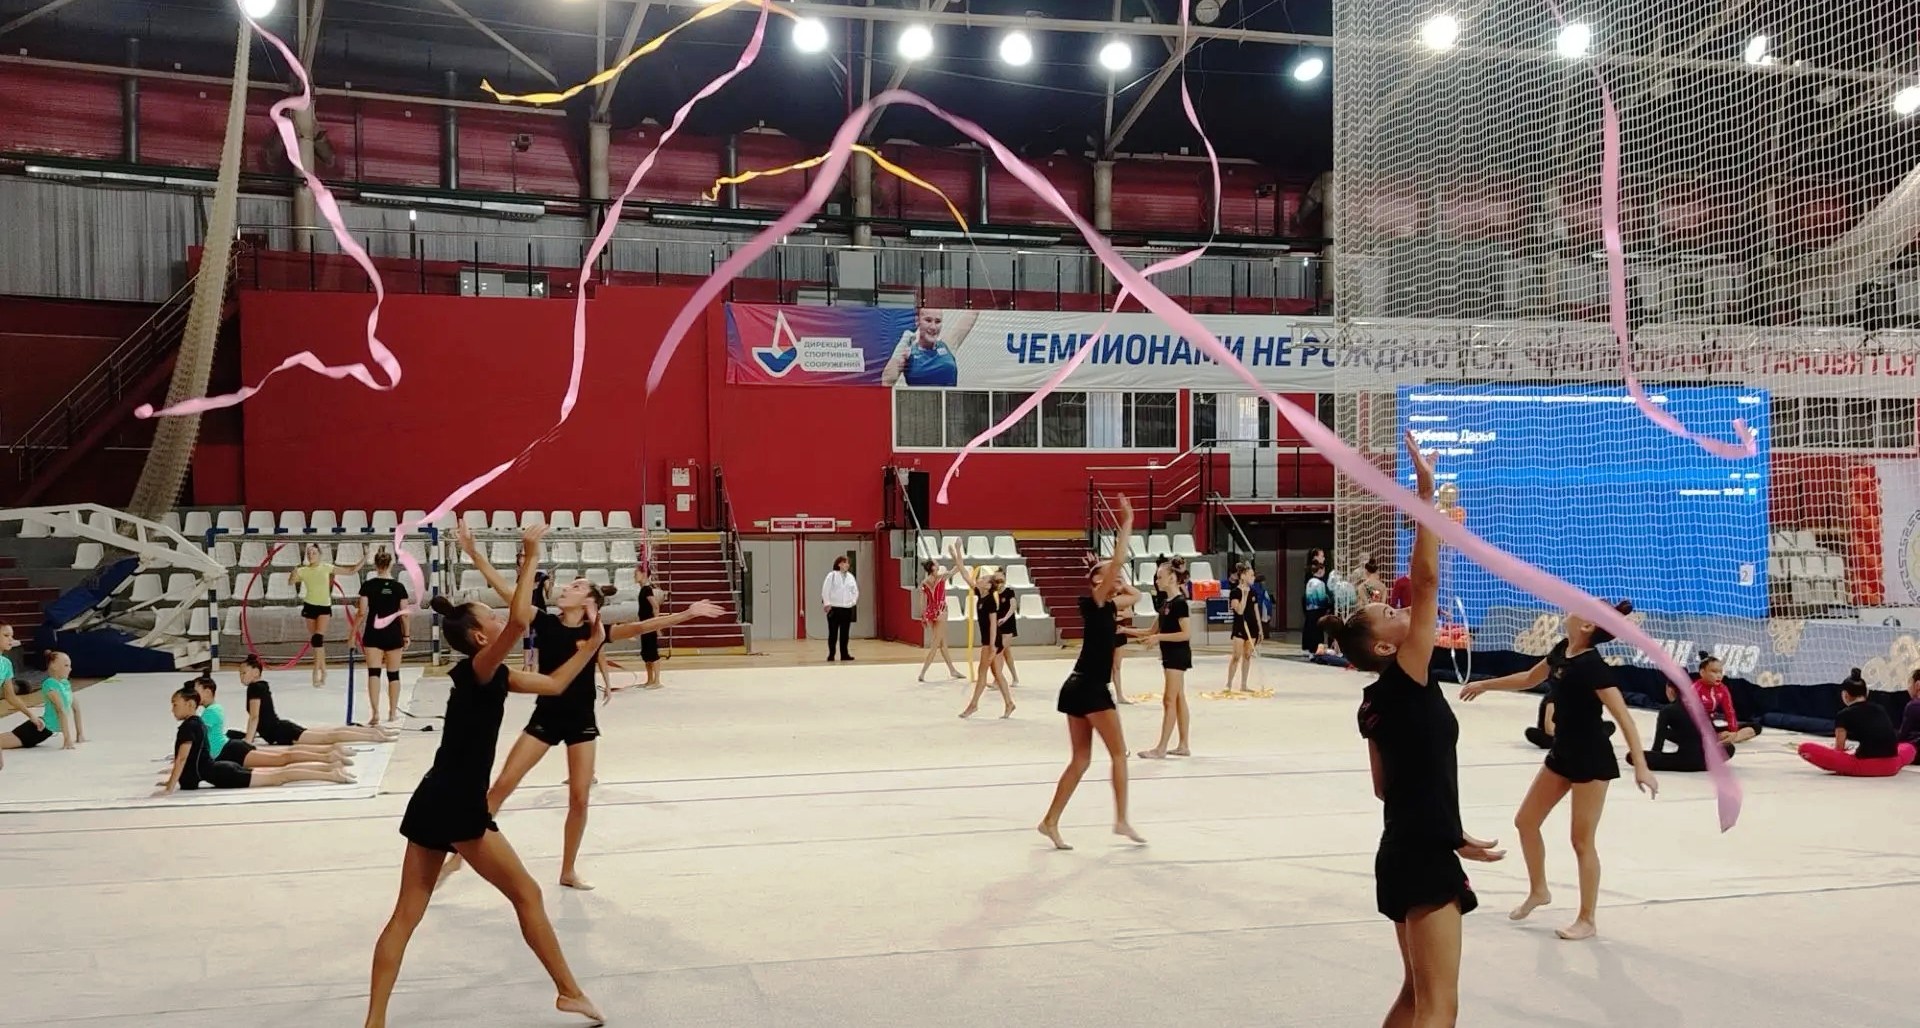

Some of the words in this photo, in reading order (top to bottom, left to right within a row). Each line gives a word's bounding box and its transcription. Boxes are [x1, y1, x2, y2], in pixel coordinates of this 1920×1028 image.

[803, 341, 848, 349] ДИРЕКЦИЯ
[804, 350, 860, 359] СПОРТИВНЫХ
[1253, 336, 1291, 366] НЕ
[804, 360, 861, 369] СООРУЖЕНИЙ
[1459, 429, 1496, 443] Дарья
[1741, 570, 1749, 583] 2
